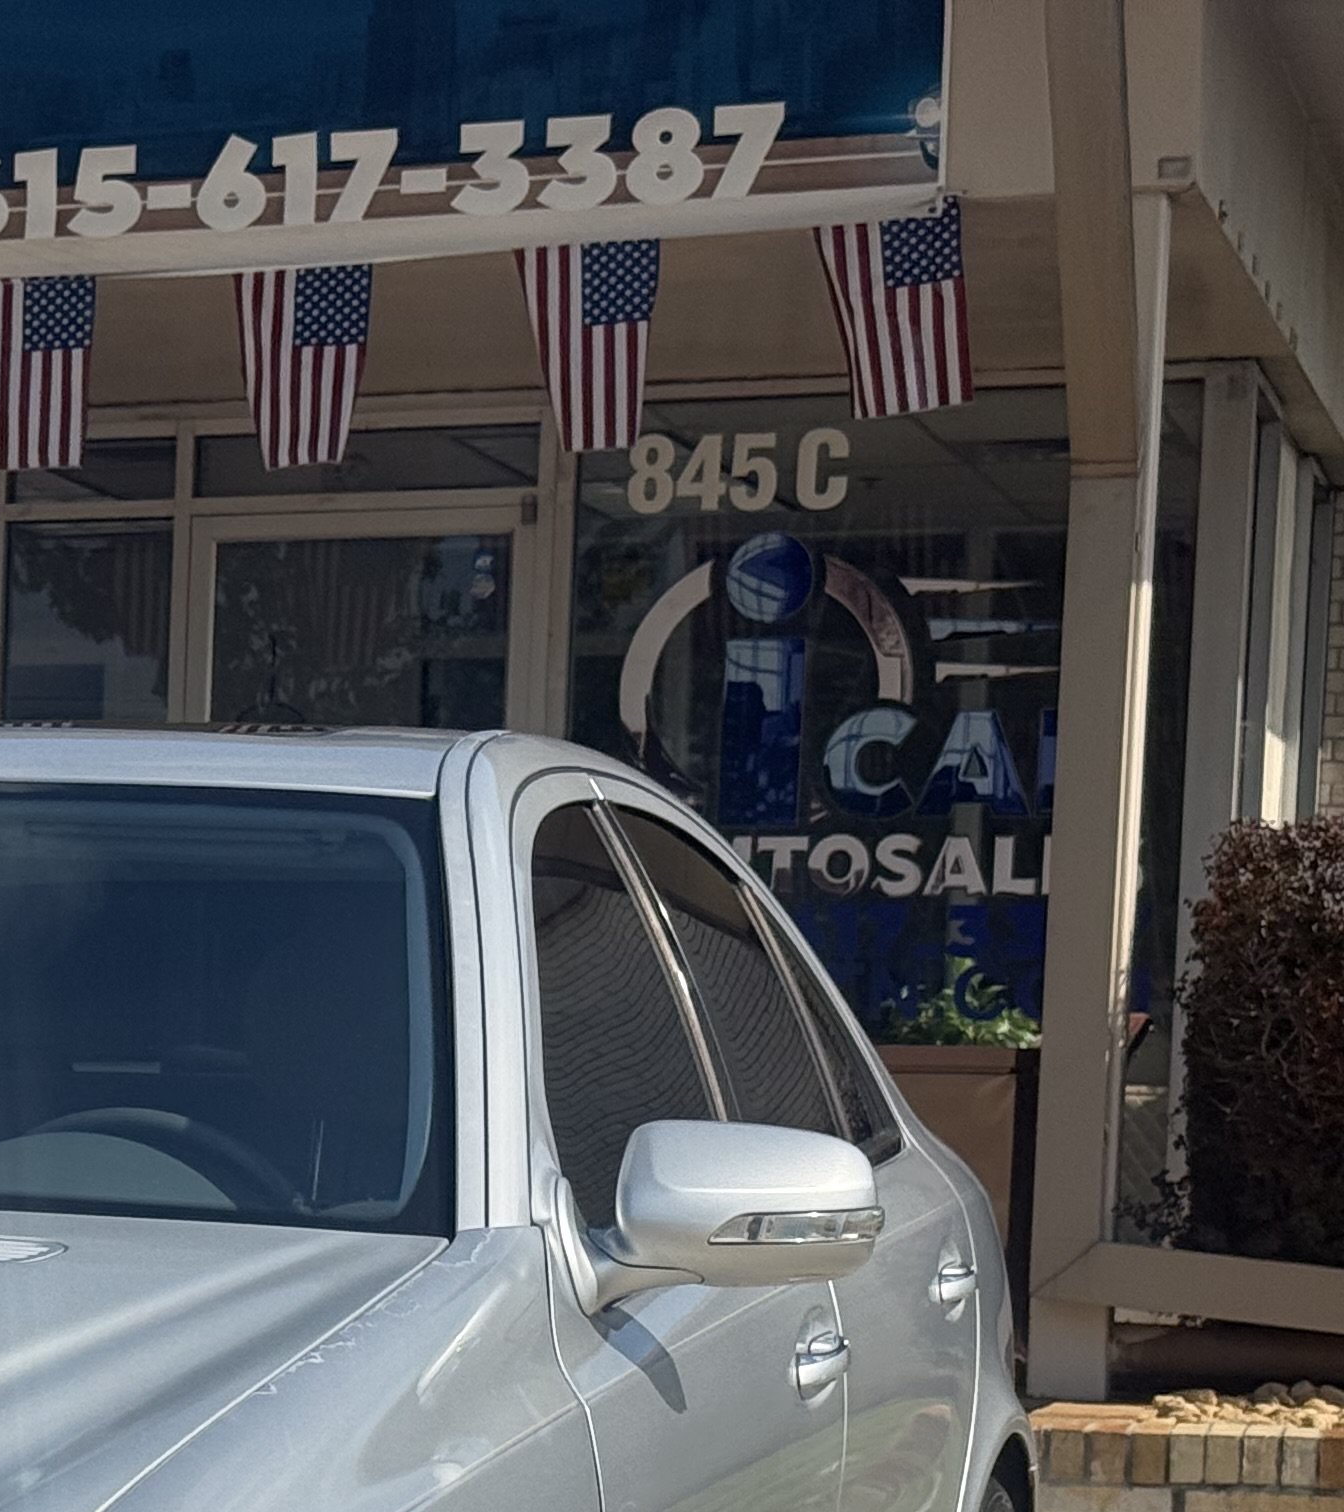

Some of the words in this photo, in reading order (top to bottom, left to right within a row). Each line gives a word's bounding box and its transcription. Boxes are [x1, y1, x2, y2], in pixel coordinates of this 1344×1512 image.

[626, 431, 778, 516] 845
[795, 427, 851, 513] C
[823, 707, 1057, 818] CA
